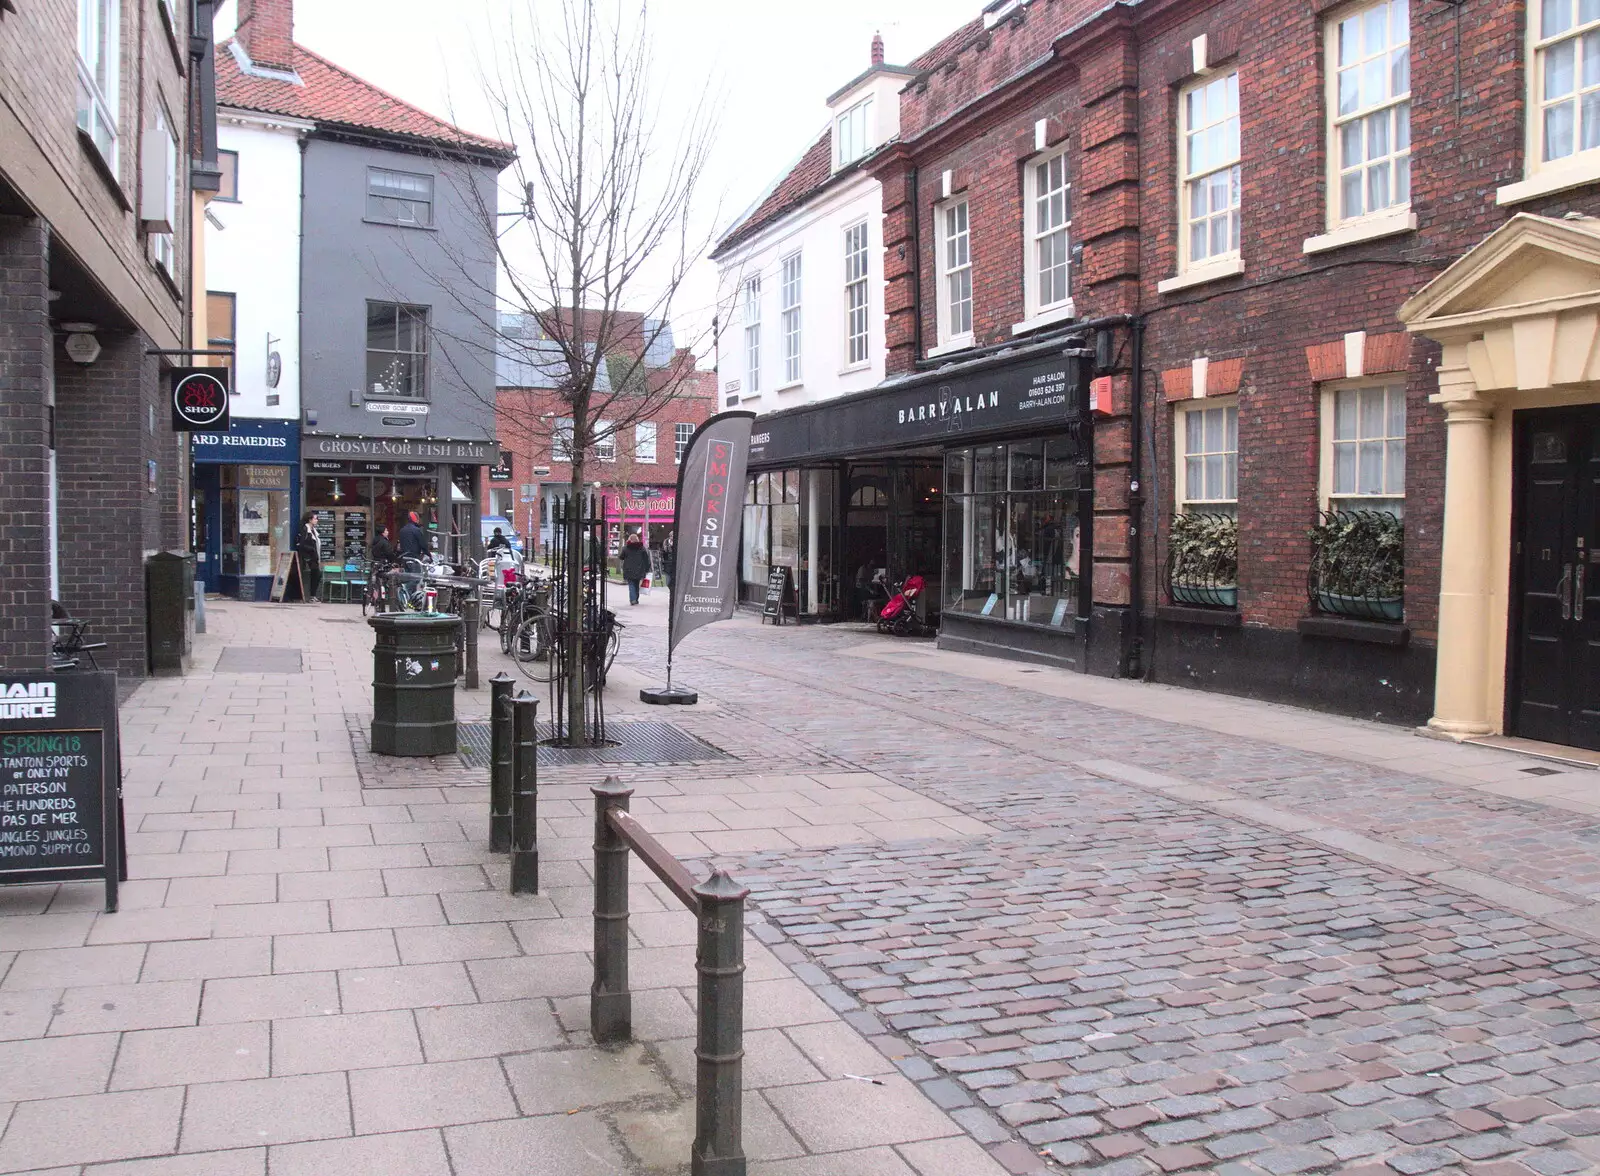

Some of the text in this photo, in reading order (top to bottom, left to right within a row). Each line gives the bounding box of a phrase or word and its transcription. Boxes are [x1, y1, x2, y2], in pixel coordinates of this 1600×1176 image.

[1033, 371, 1065, 385] HAIR SALON
[1028, 387, 1044, 397] 01603
[1044, 384, 1054, 394] 624
[898, 391, 999, 424] BARRY ALAN
[1019, 395, 1065, 410] BARRY-ALAN.COM
[185, 406, 217, 414] SHOP
[222, 435, 286, 447] REMEDIES
[319, 440, 484, 457] GROSVENOR FISH BAR
[244, 467, 286, 476] THERAPY
[249, 476, 281, 486] ROOMS
[684, 594, 722, 604] Electronic
[683, 603, 721, 614] Cigarettes
[0, 702, 56, 719] URCE
[46, 755, 88, 768] SPORTS
[27, 768, 51, 779] ONLY
[54, 767, 69, 777] NY
[4, 782, 67, 795] PATERSON
[16, 797, 76, 811] HUNDREDS
[2, 811, 79, 827] PAS DE MER
[43, 828, 88, 843] JUNGLES
[41, 844, 72, 856] SUPPY
[75, 842, 93, 854] CO.
